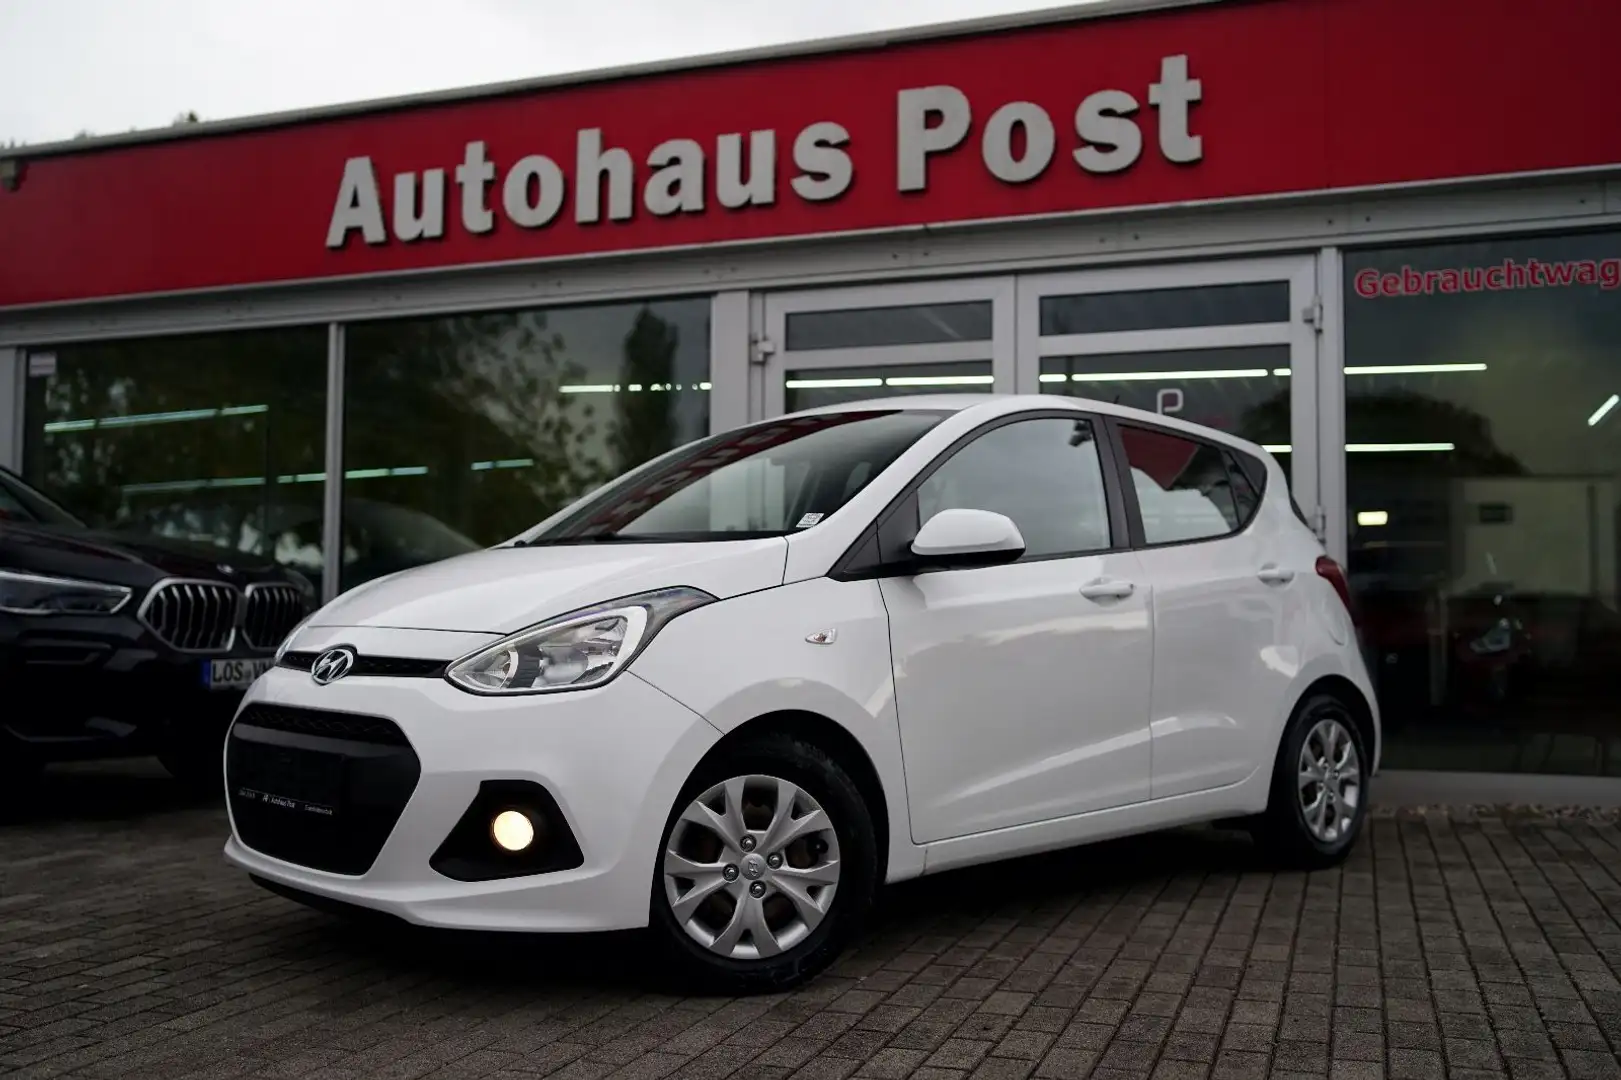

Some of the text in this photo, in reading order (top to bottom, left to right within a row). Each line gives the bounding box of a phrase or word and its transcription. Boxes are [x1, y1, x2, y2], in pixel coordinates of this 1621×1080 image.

[326, 54, 1203, 248] Autohaus Post
[1353, 258, 1621, 301] Gebrauchtwag
[212, 661, 243, 682] LOS
